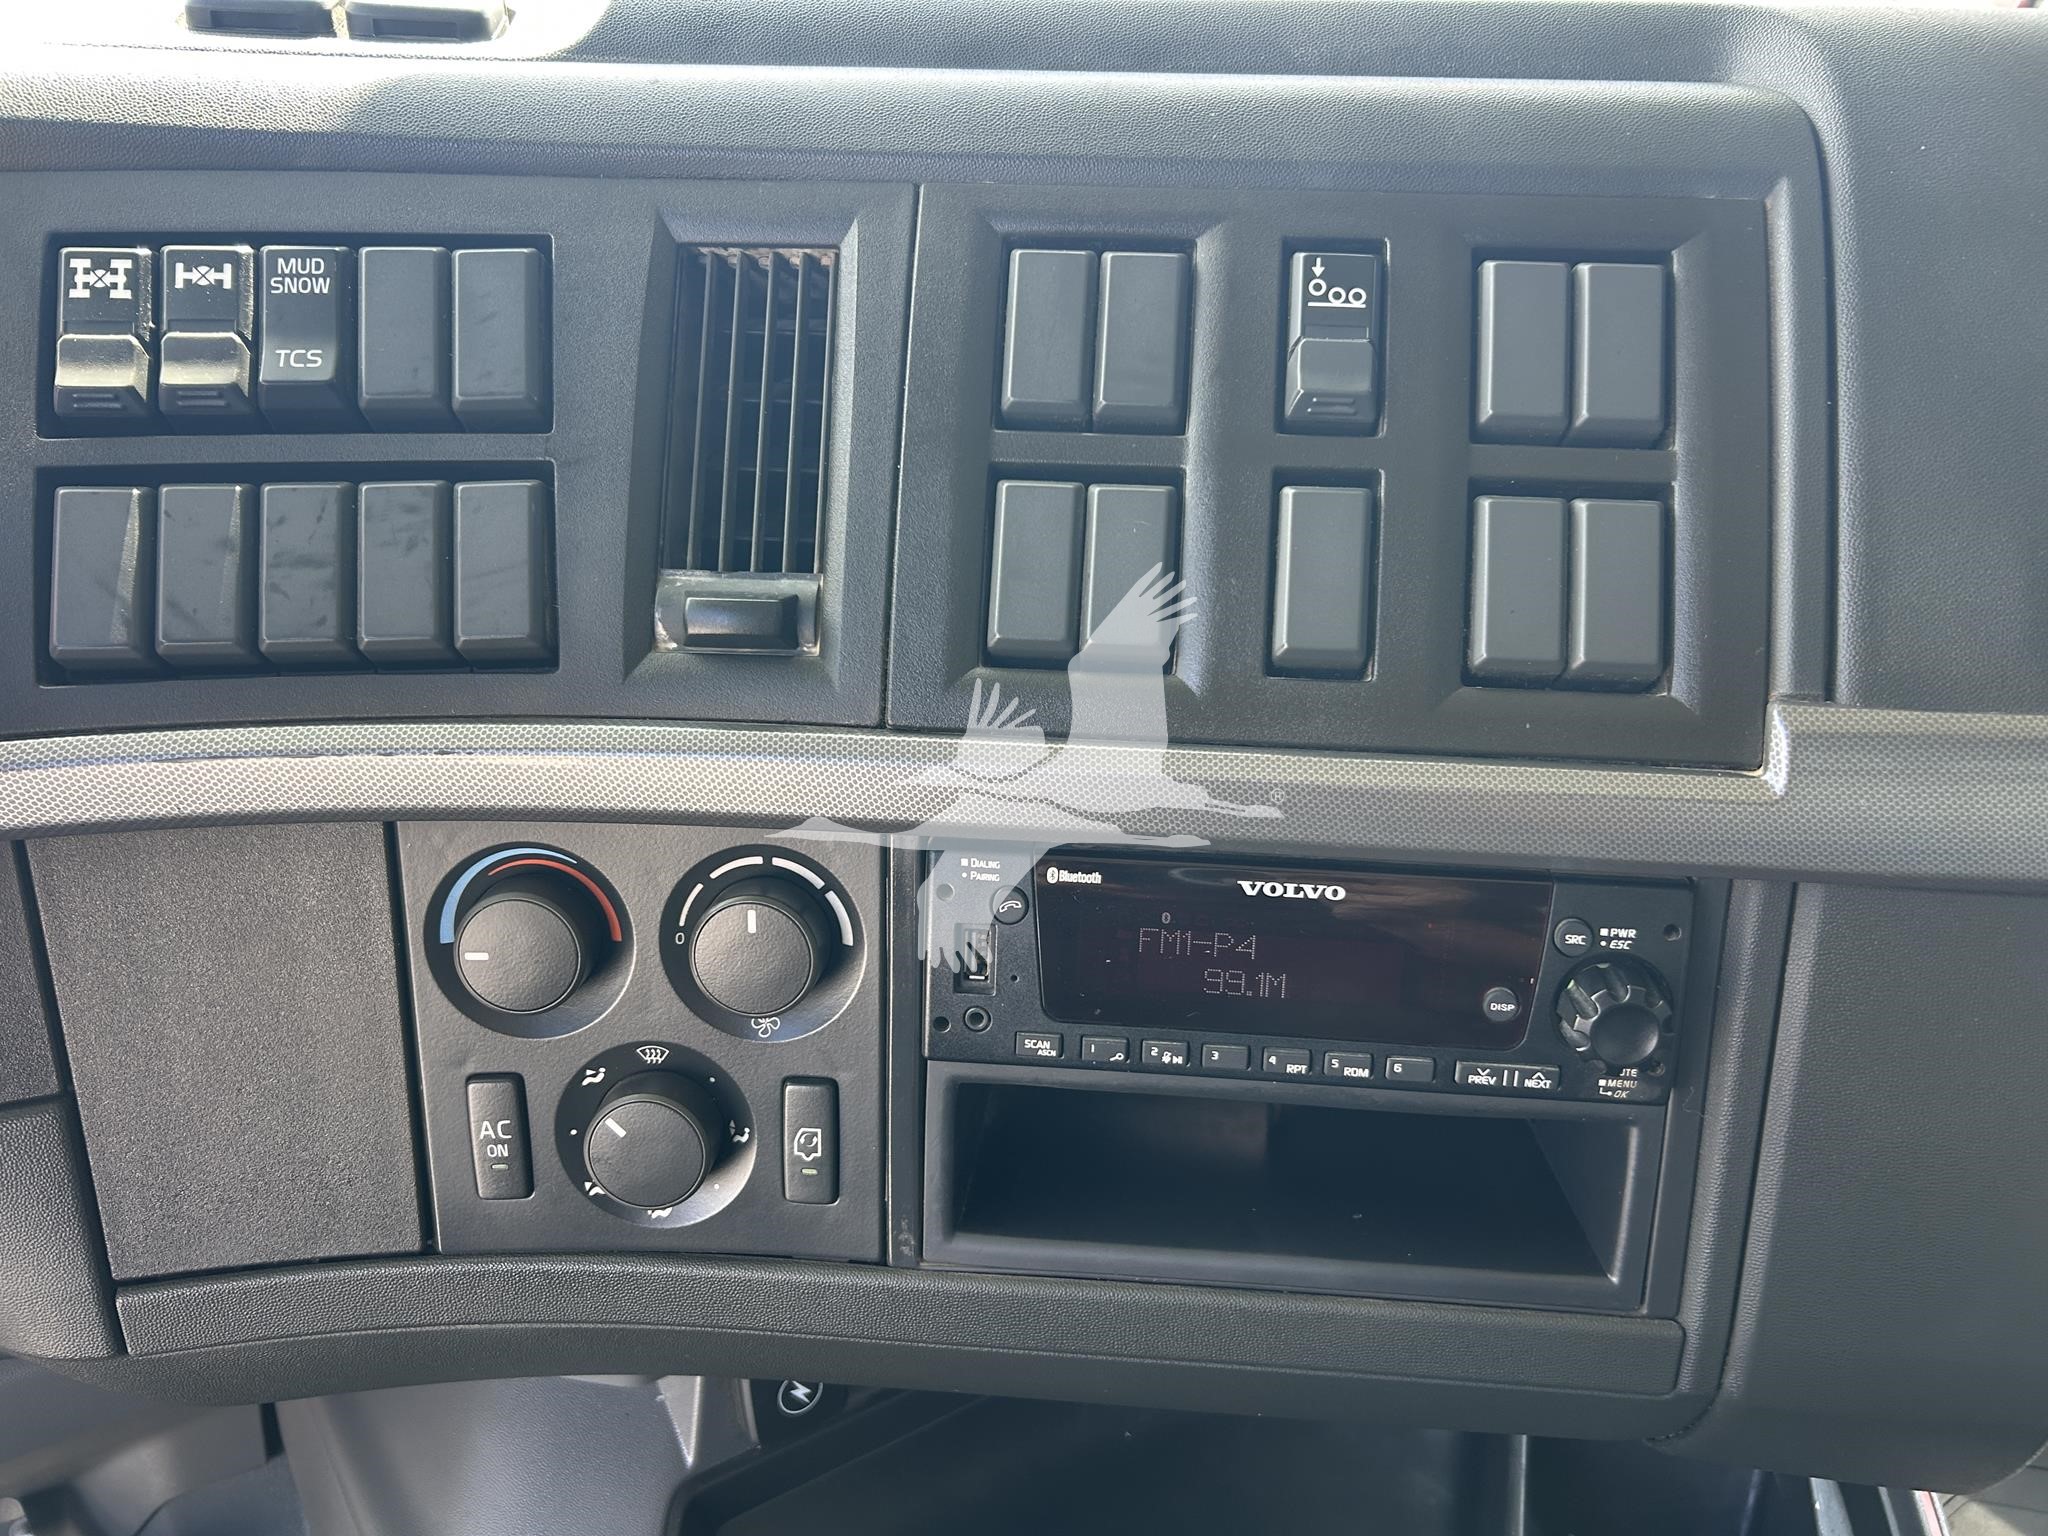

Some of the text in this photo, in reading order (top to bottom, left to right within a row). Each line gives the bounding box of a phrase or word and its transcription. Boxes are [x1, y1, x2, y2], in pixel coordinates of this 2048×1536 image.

[277, 257, 325, 275] MUD
[270, 277, 331, 294] SNOW
[275, 349, 323, 368] TCS
[1058, 869, 1102, 884] Bluetooth
[1237, 880, 1347, 901] VOLVO
[675, 932, 685, 945] 0
[1609, 927, 1637, 939] PWR
[1138, 927, 1257, 960] FM1-P4
[1564, 934, 1588, 946] SRC
[1609, 940, 1633, 950] ESC
[1203, 968, 1287, 999] 99.1M
[1490, 1002, 1516, 1012] DISP
[1024, 1039, 1051, 1049] SCAN
[1090, 1043, 1095, 1053] 1
[1150, 1047, 1159, 1056] 2
[1211, 1051, 1219, 1060] 3
[1268, 1055, 1277, 1065] 4
[1331, 1059, 1339, 1068] 5
[1286, 1064, 1308, 1075] RPT
[1343, 1066, 1370, 1078] RDM
[1393, 1063, 1402, 1073] 6
[1467, 1074, 1498, 1086] PREV
[1523, 1077, 1552, 1089] NEXT
[1607, 1079, 1638, 1089] MENU
[1613, 1089, 1631, 1099] OK
[480, 1120, 512, 1140] AC
[486, 1143, 509, 1158] ON
